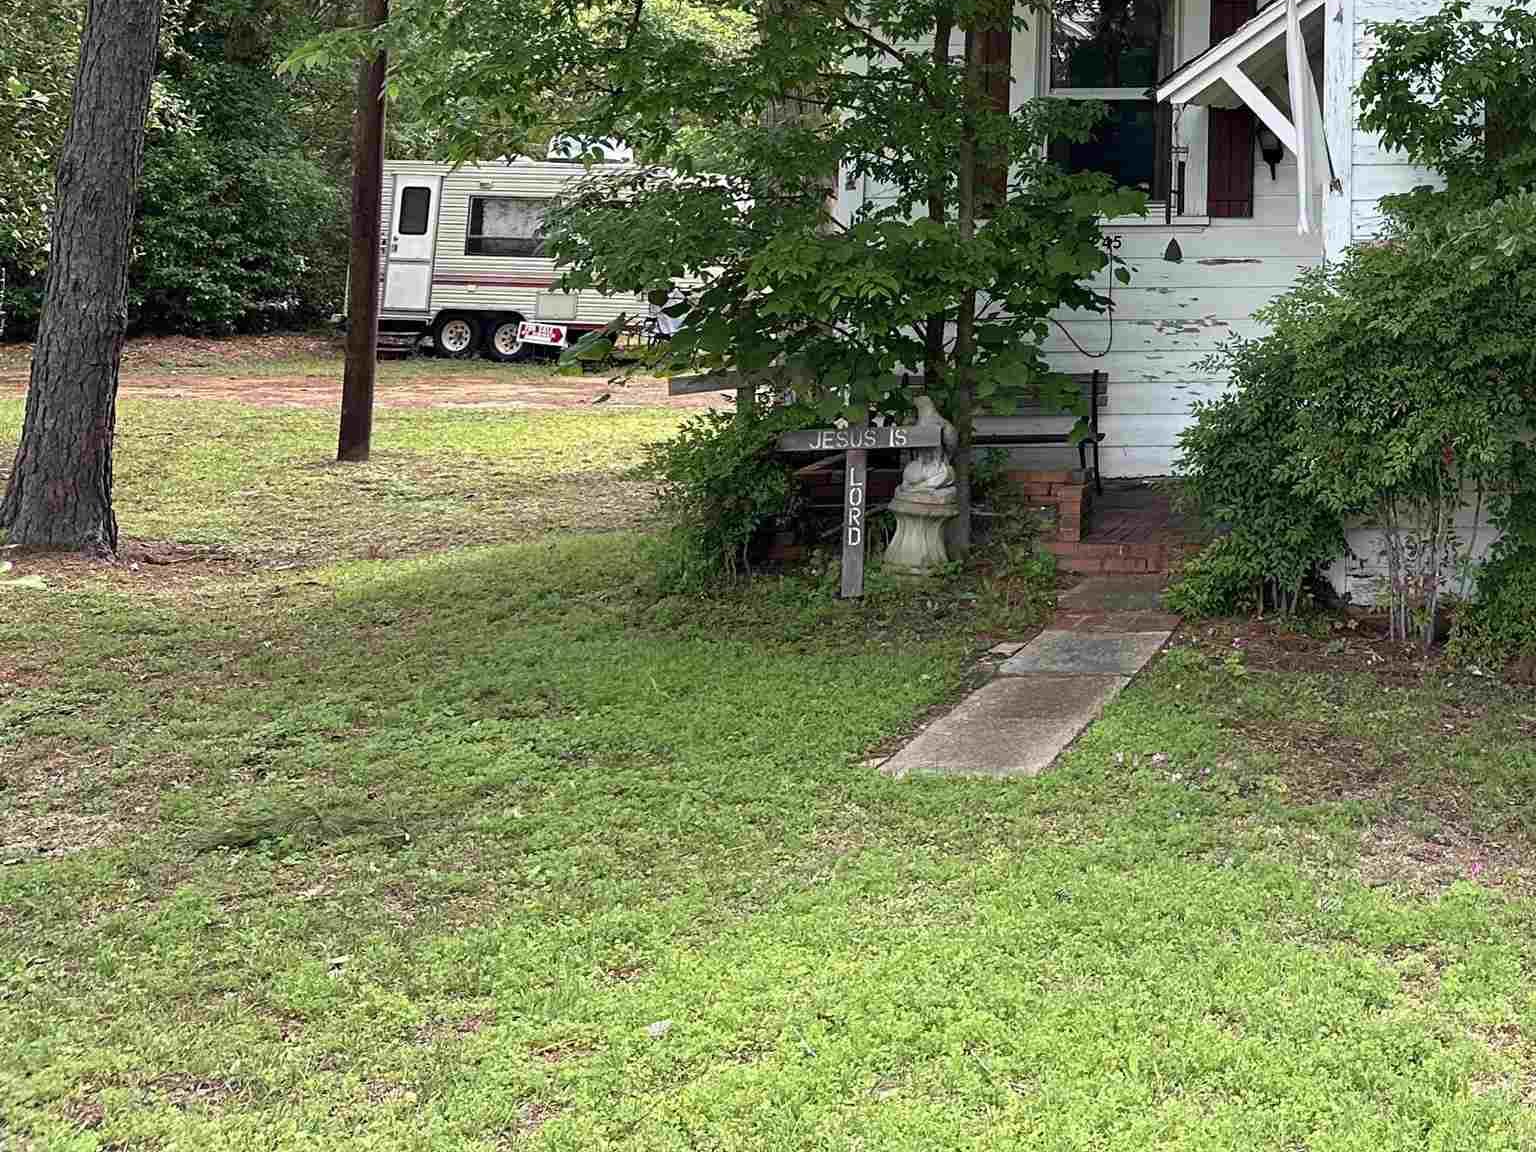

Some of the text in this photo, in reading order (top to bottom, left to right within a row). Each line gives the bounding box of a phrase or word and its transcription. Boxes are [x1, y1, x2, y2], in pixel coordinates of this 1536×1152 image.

[808, 424, 907, 449] JESUS IS
[848, 466, 863, 547] LORD
